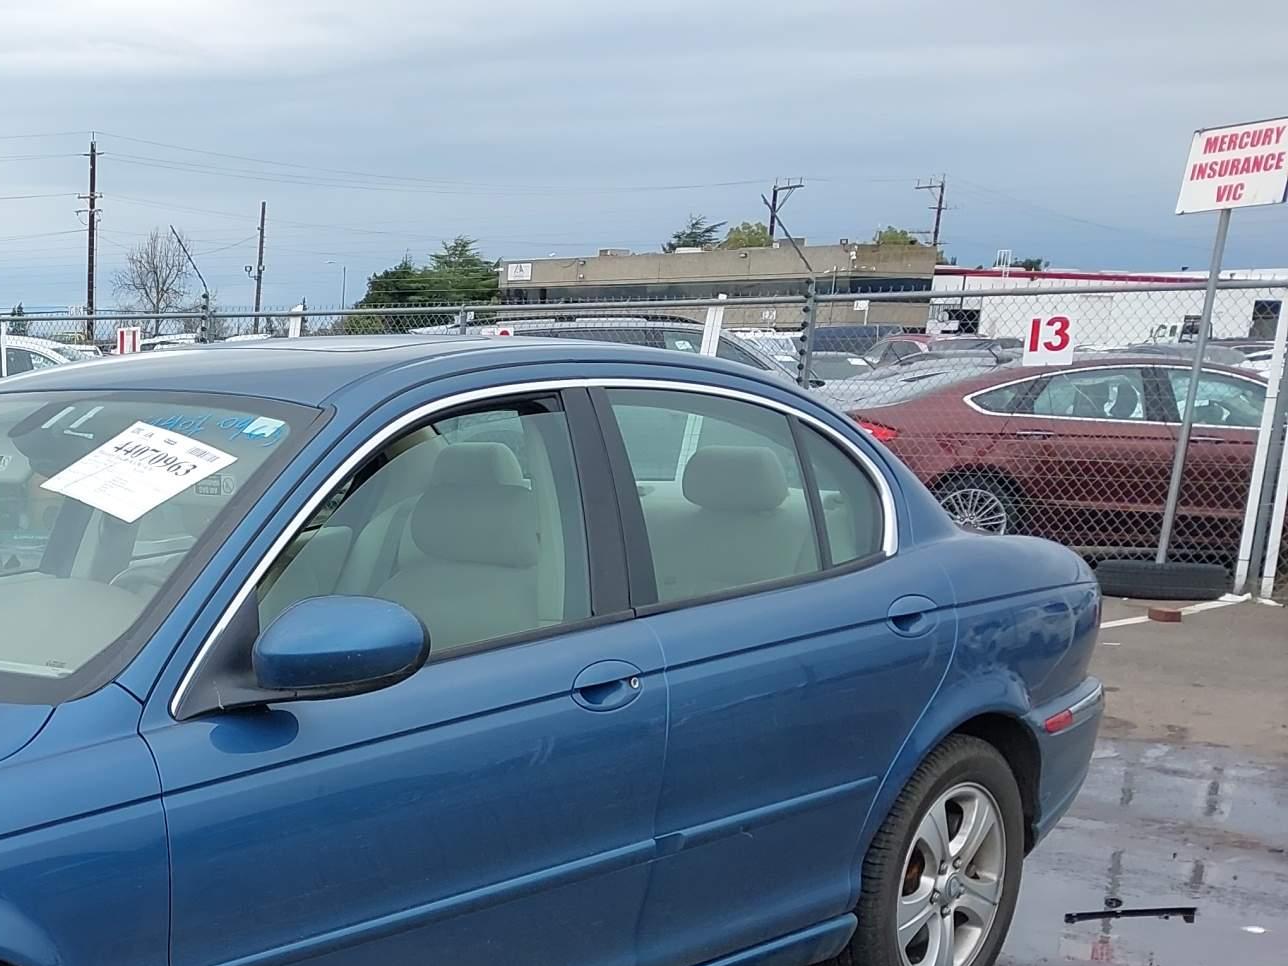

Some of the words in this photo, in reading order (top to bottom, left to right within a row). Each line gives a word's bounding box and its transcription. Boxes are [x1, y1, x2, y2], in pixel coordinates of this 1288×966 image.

[1203, 126, 1286, 154] MERCURY
[1190, 152, 1286, 181] INSURANCE
[1216, 183, 1245, 203] VIC
[1029, 316, 1070, 352] 13
[113, 441, 198, 476] 44070963
